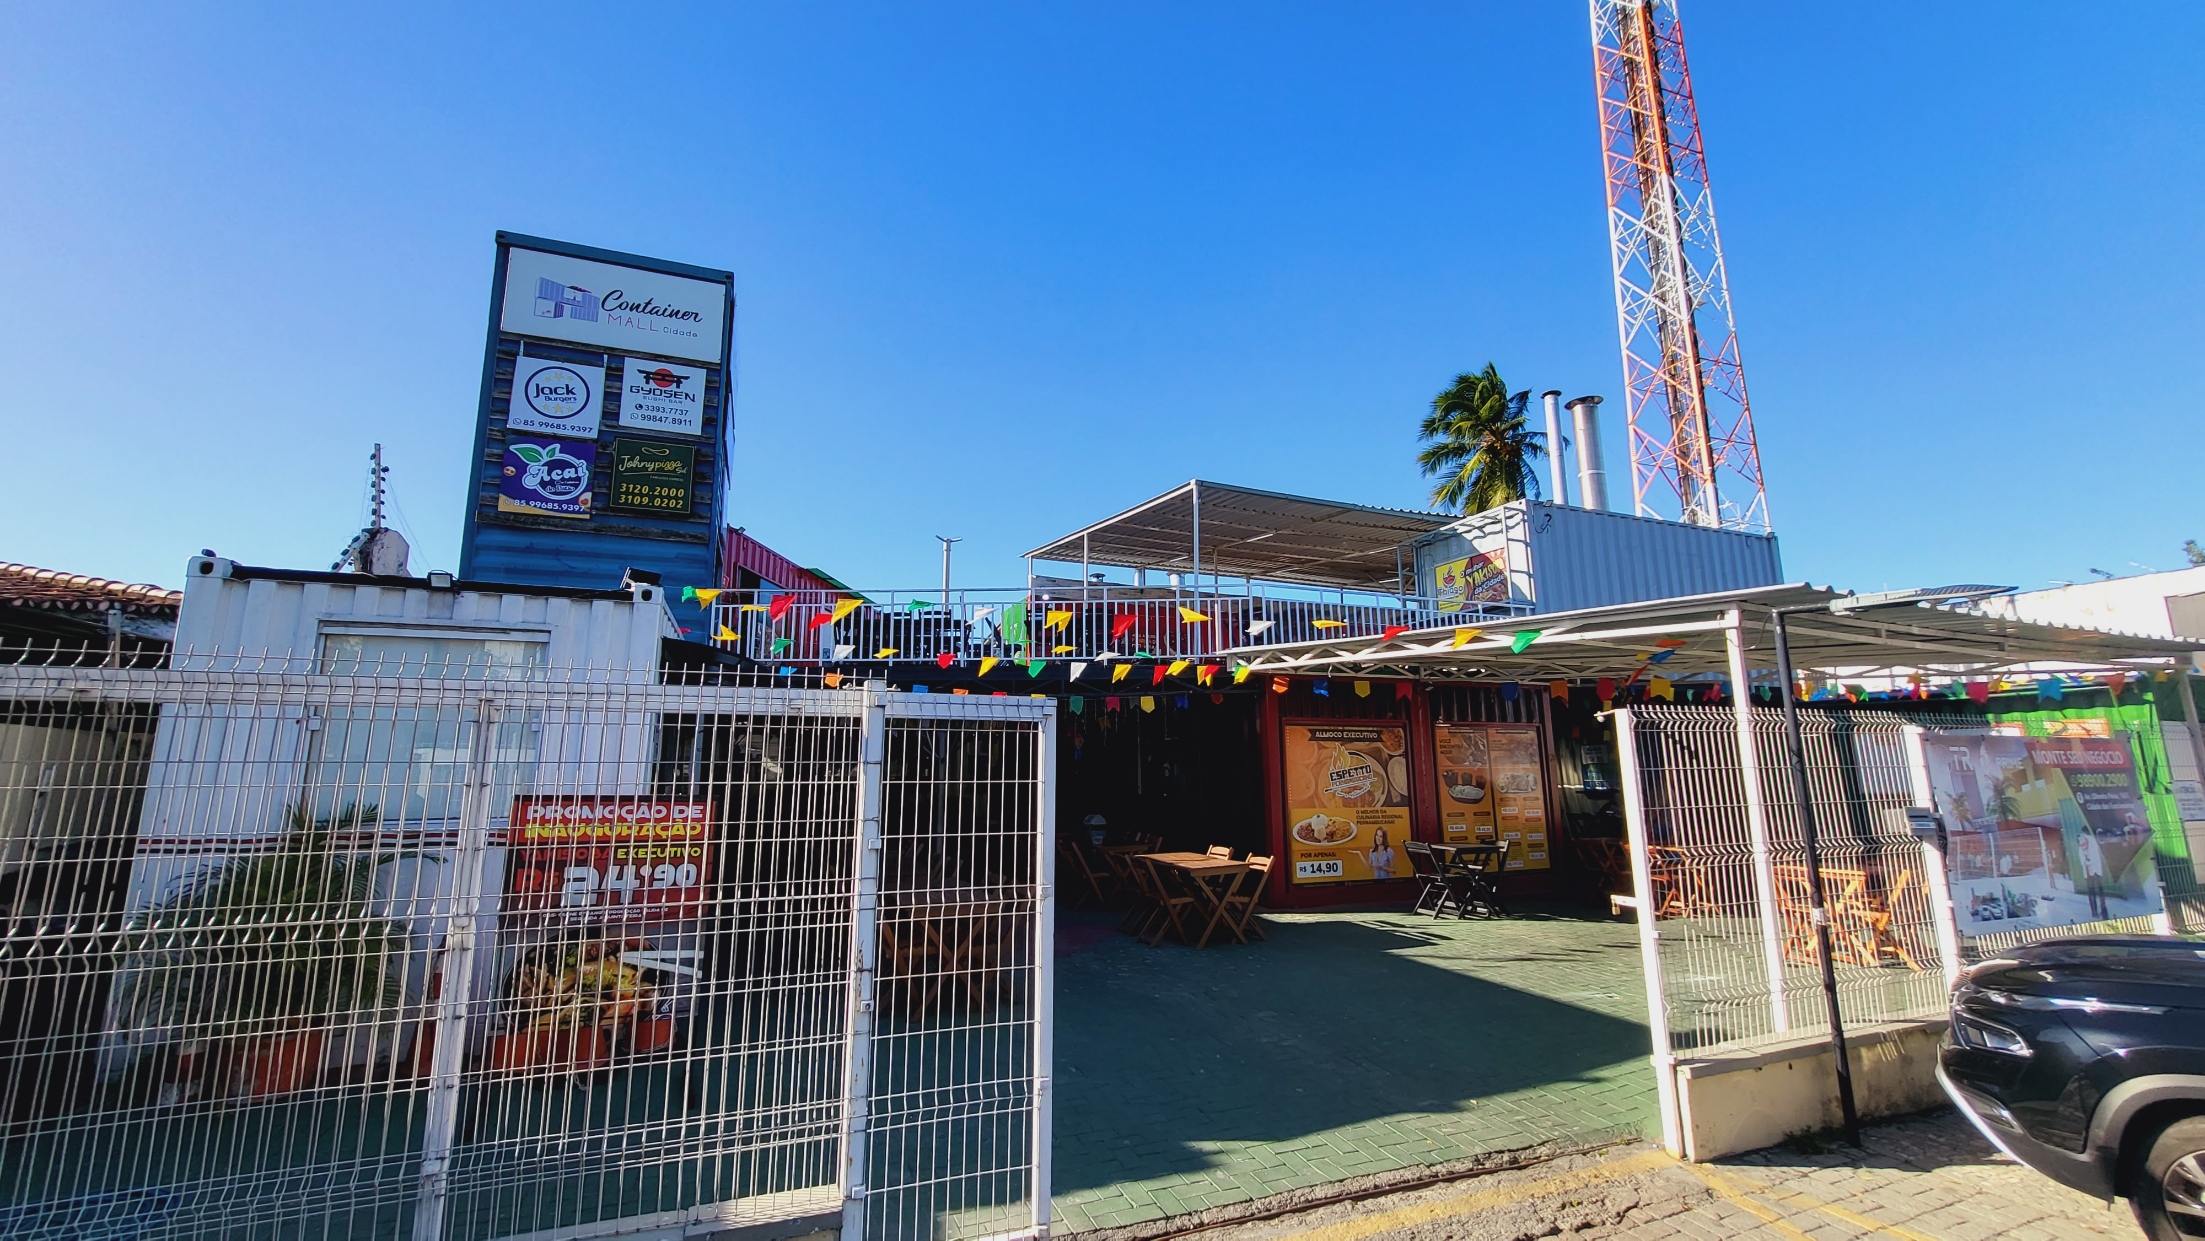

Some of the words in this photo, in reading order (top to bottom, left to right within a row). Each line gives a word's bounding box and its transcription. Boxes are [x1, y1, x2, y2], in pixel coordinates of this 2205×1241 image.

[601, 289, 703, 323] Container
[607, 313, 659, 333] MALL
[663, 326, 698, 338] Cidade
[533, 383, 577, 398] Jack
[630, 385, 696, 403] GYOSEN
[644, 404, 689, 416] 3393.7737
[523, 419, 535, 427] 85
[538, 421, 593, 433] 99685.9397
[640, 413, 692, 427] 99847.8911
[619, 483, 685, 497] 3120.2000
[529, 500, 585, 512] 99685.9397
[618, 494, 683, 508] 3109.0202
[2031, 750, 2066, 765] MONTE
[2066, 750, 2082, 765] SEU
[1330, 765, 1372, 781] ESPETTO
[527, 802, 667, 821] PROMOÇÃO
[673, 805, 704, 819] DE
[524, 819, 702, 838] INAUGURAÇÃO
[617, 847, 701, 859] EXECUTIVO
[1299, 865, 1307, 873] R$
[1310, 862, 1339, 875] 14,90
